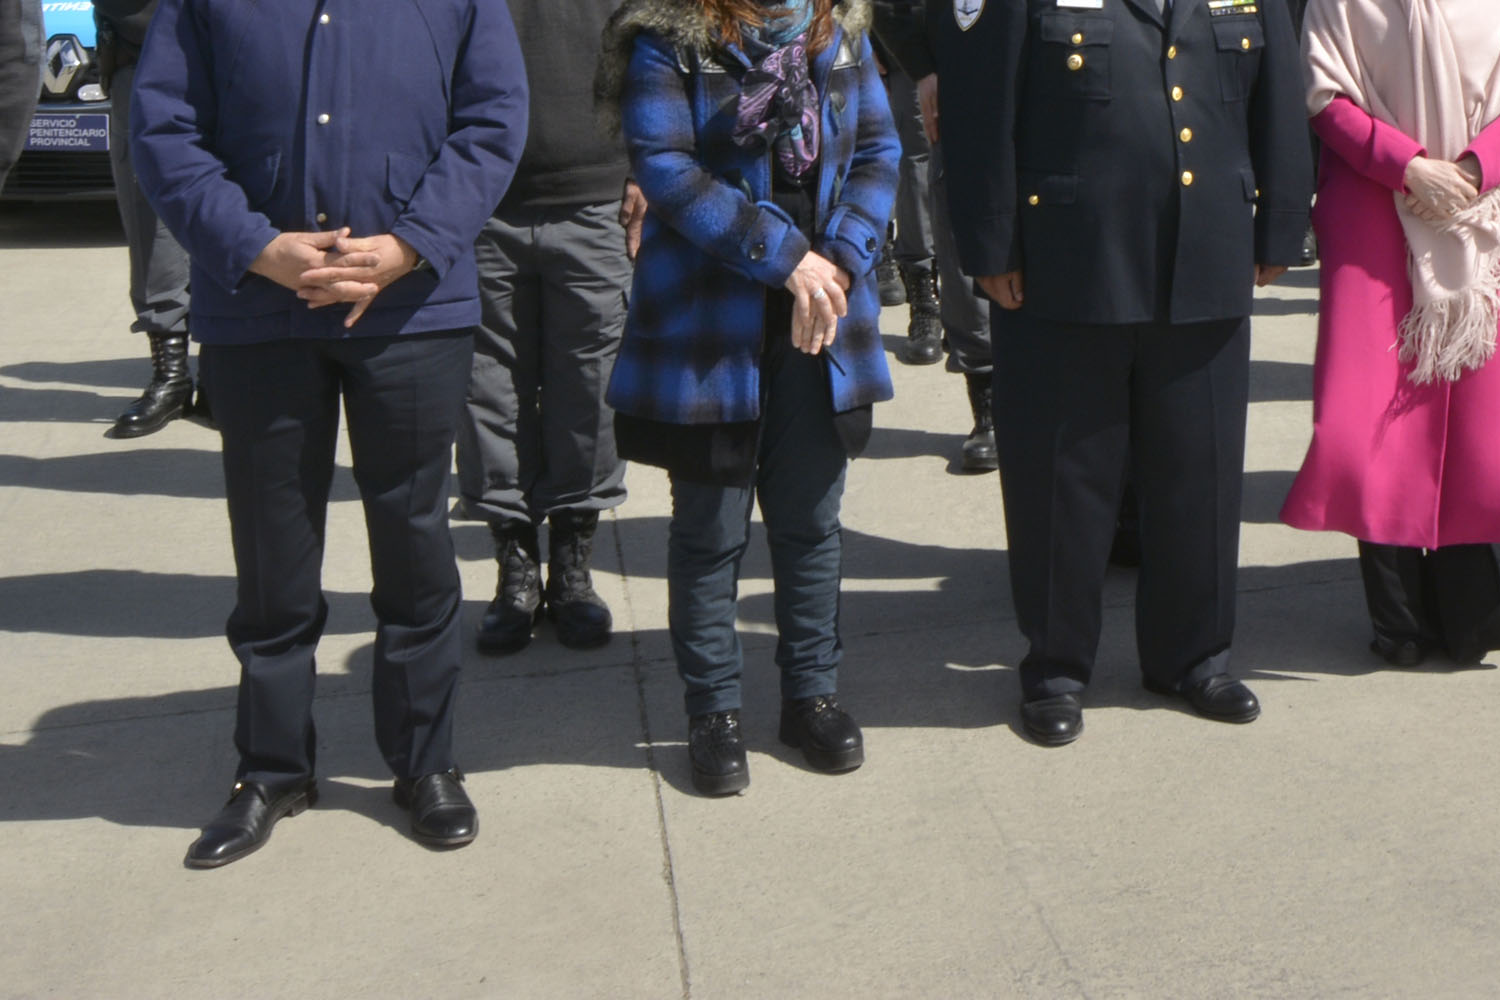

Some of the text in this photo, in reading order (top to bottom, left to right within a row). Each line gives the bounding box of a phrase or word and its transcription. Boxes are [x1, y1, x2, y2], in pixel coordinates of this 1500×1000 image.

[30, 119, 77, 128] SERVICIO
[30, 128, 106, 137] PENITENCIARIO
[30, 138, 91, 146] PROVINCIAL
